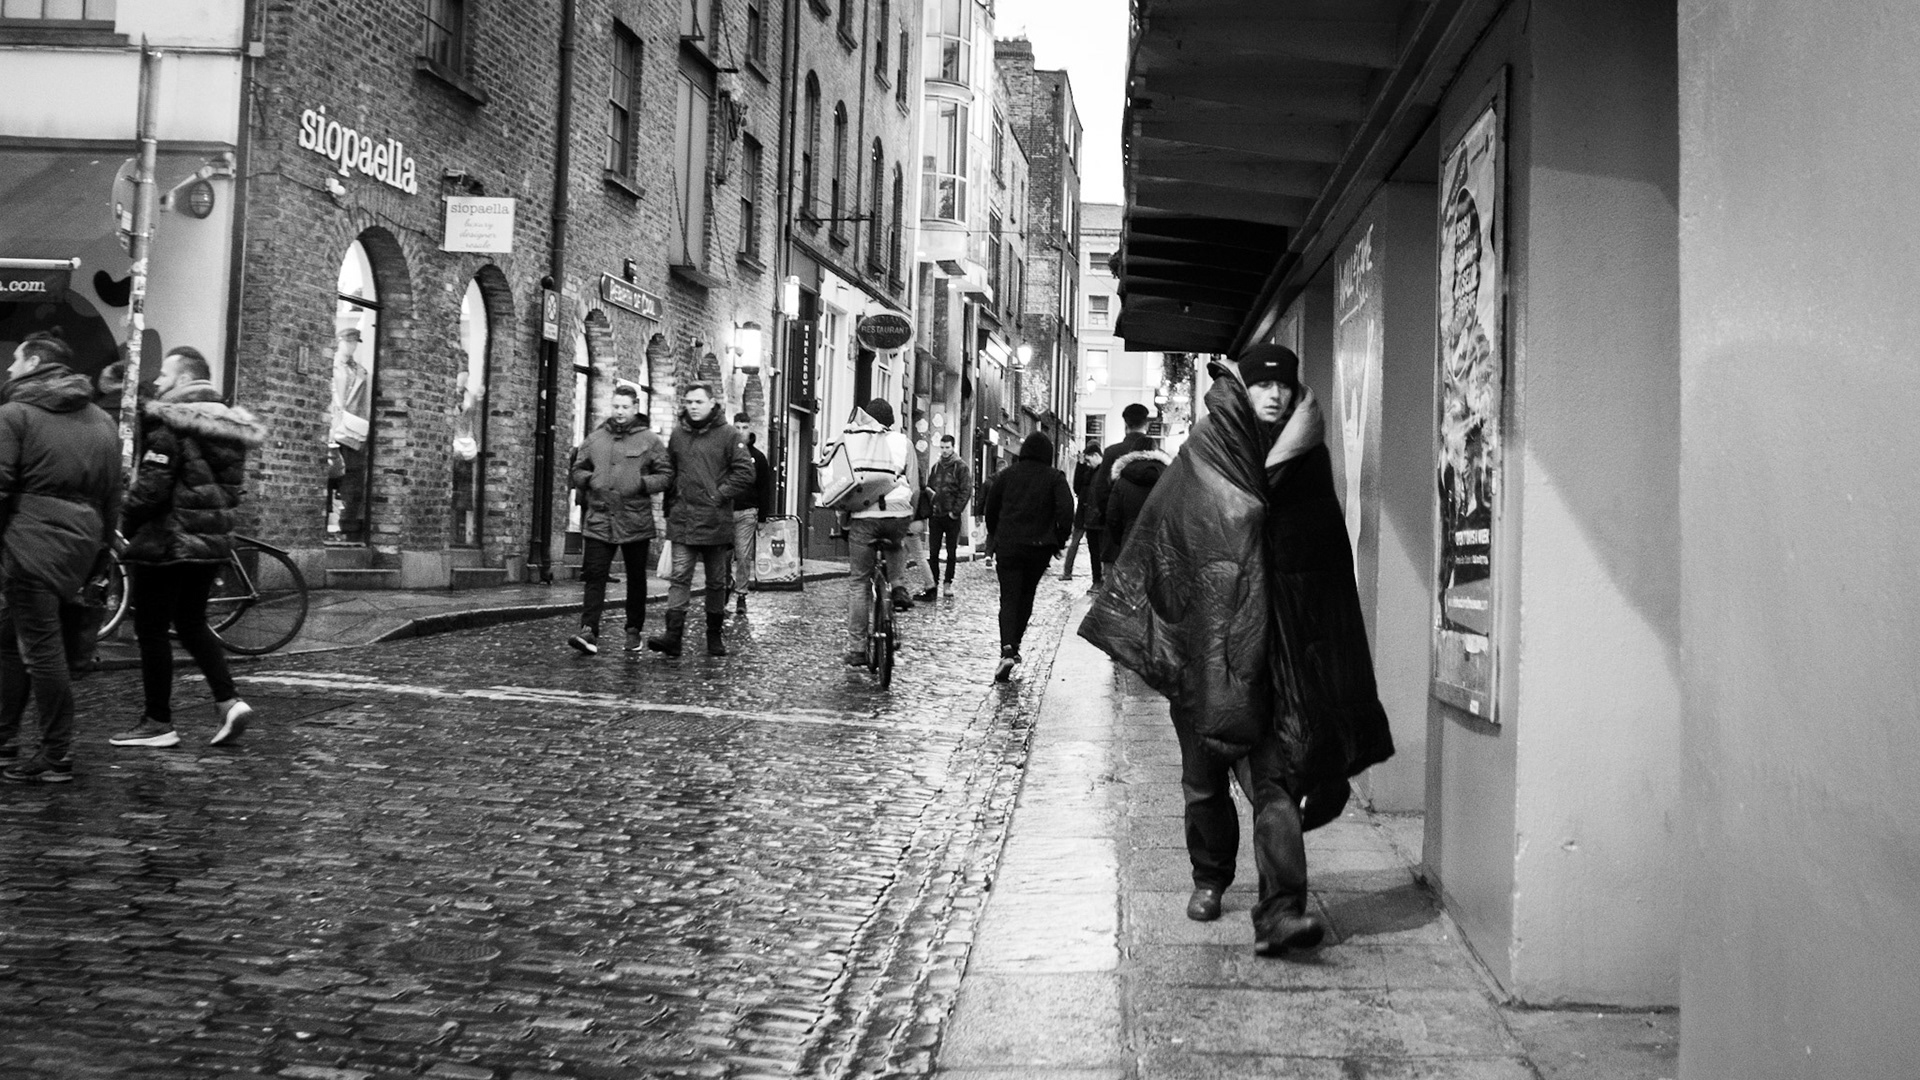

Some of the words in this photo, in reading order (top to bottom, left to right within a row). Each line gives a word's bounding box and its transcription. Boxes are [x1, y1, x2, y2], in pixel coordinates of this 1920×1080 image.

[299, 104, 418, 195] siopaella
[450, 203, 509, 215] siopaella
[861, 325, 909, 334] RESTAURANT
